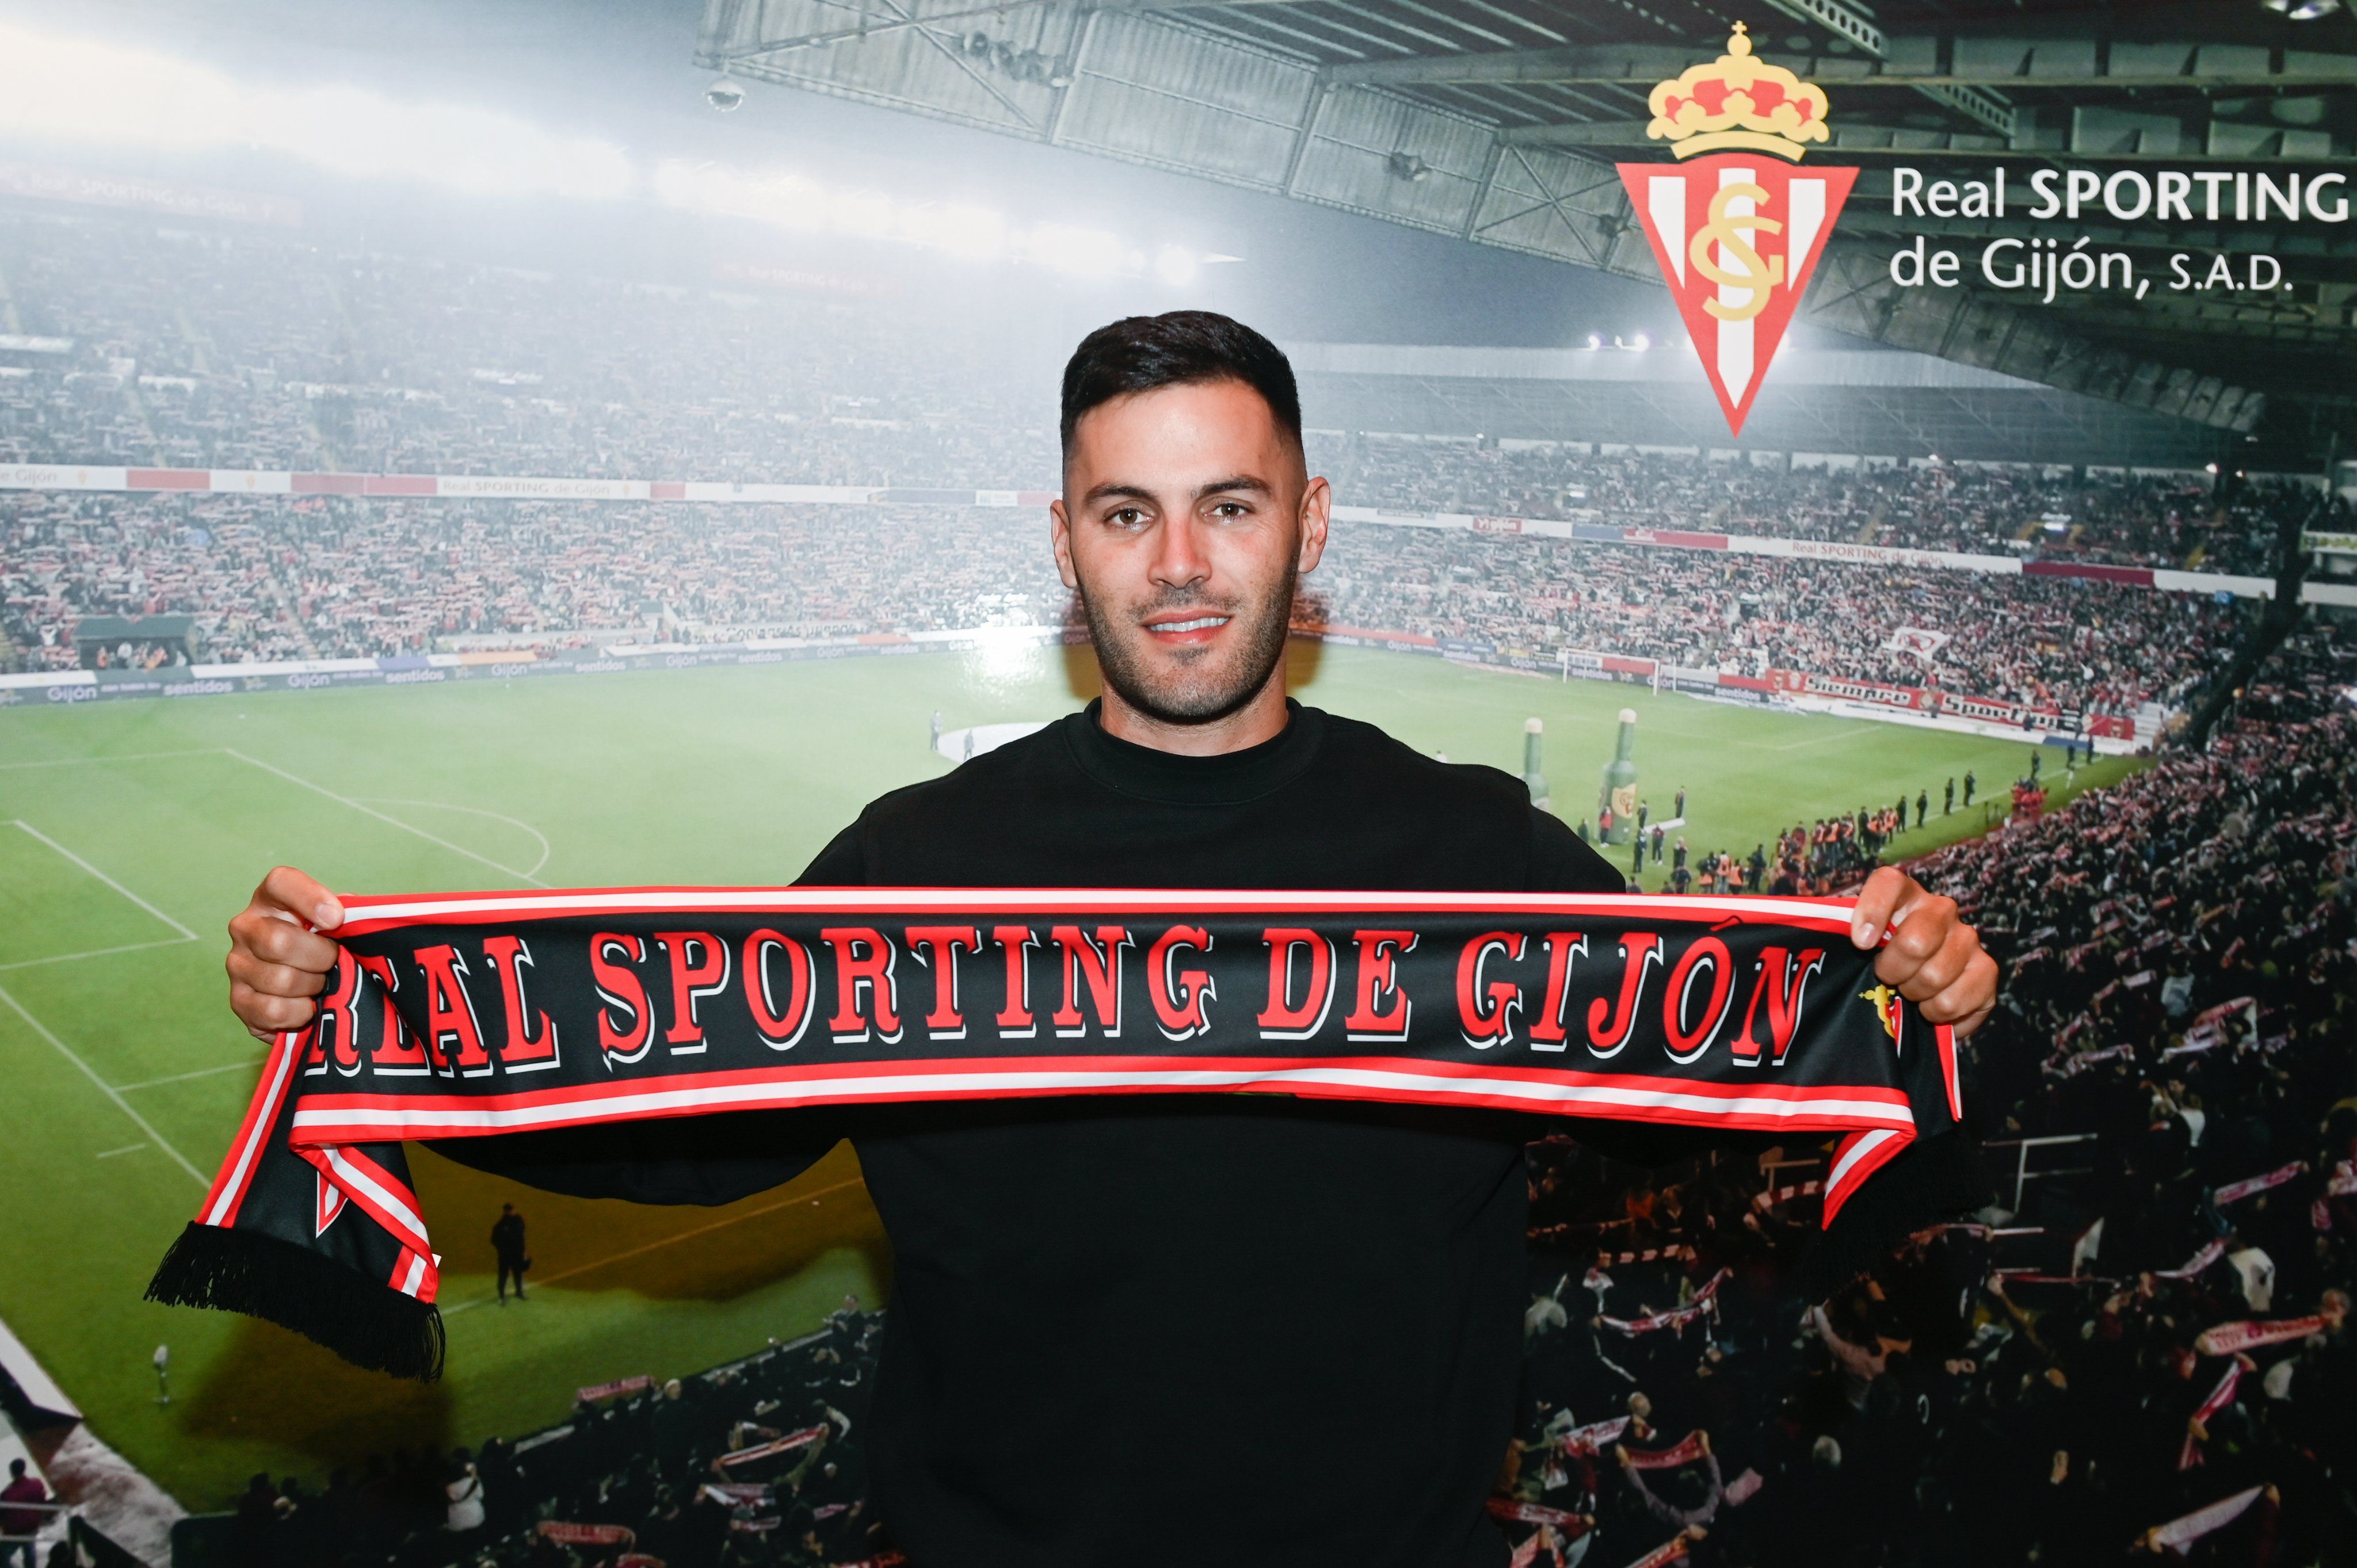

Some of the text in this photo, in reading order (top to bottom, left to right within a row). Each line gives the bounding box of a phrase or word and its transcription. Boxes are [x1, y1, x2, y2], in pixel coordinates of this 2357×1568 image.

[80, 179, 174, 205] SPORTING
[1893, 167, 2350, 223] Real SPORTING
[1890, 235, 2293, 303] de Gijón, S.A.D.
[15, 468, 58, 486] Gijón
[443, 481, 610, 497] Real SPORTING de Gijón
[1792, 541, 1817, 554] Real
[1821, 543, 1887, 561] SPORTING
[1891, 551, 1907, 563] de
[491, 662, 528, 678] Gijón
[575, 659, 627, 674] sentidos
[666, 653, 697, 669] Gijón
[288, 672, 330, 690] Gijón
[386, 668, 445, 685] sentidos
[47, 683, 98, 704] Gijón
[163, 680, 233, 696] sentidos
[304, 935, 560, 1078] REAL
[590, 925, 1217, 1074] SPORTING
[1257, 927, 1420, 1043] DE
